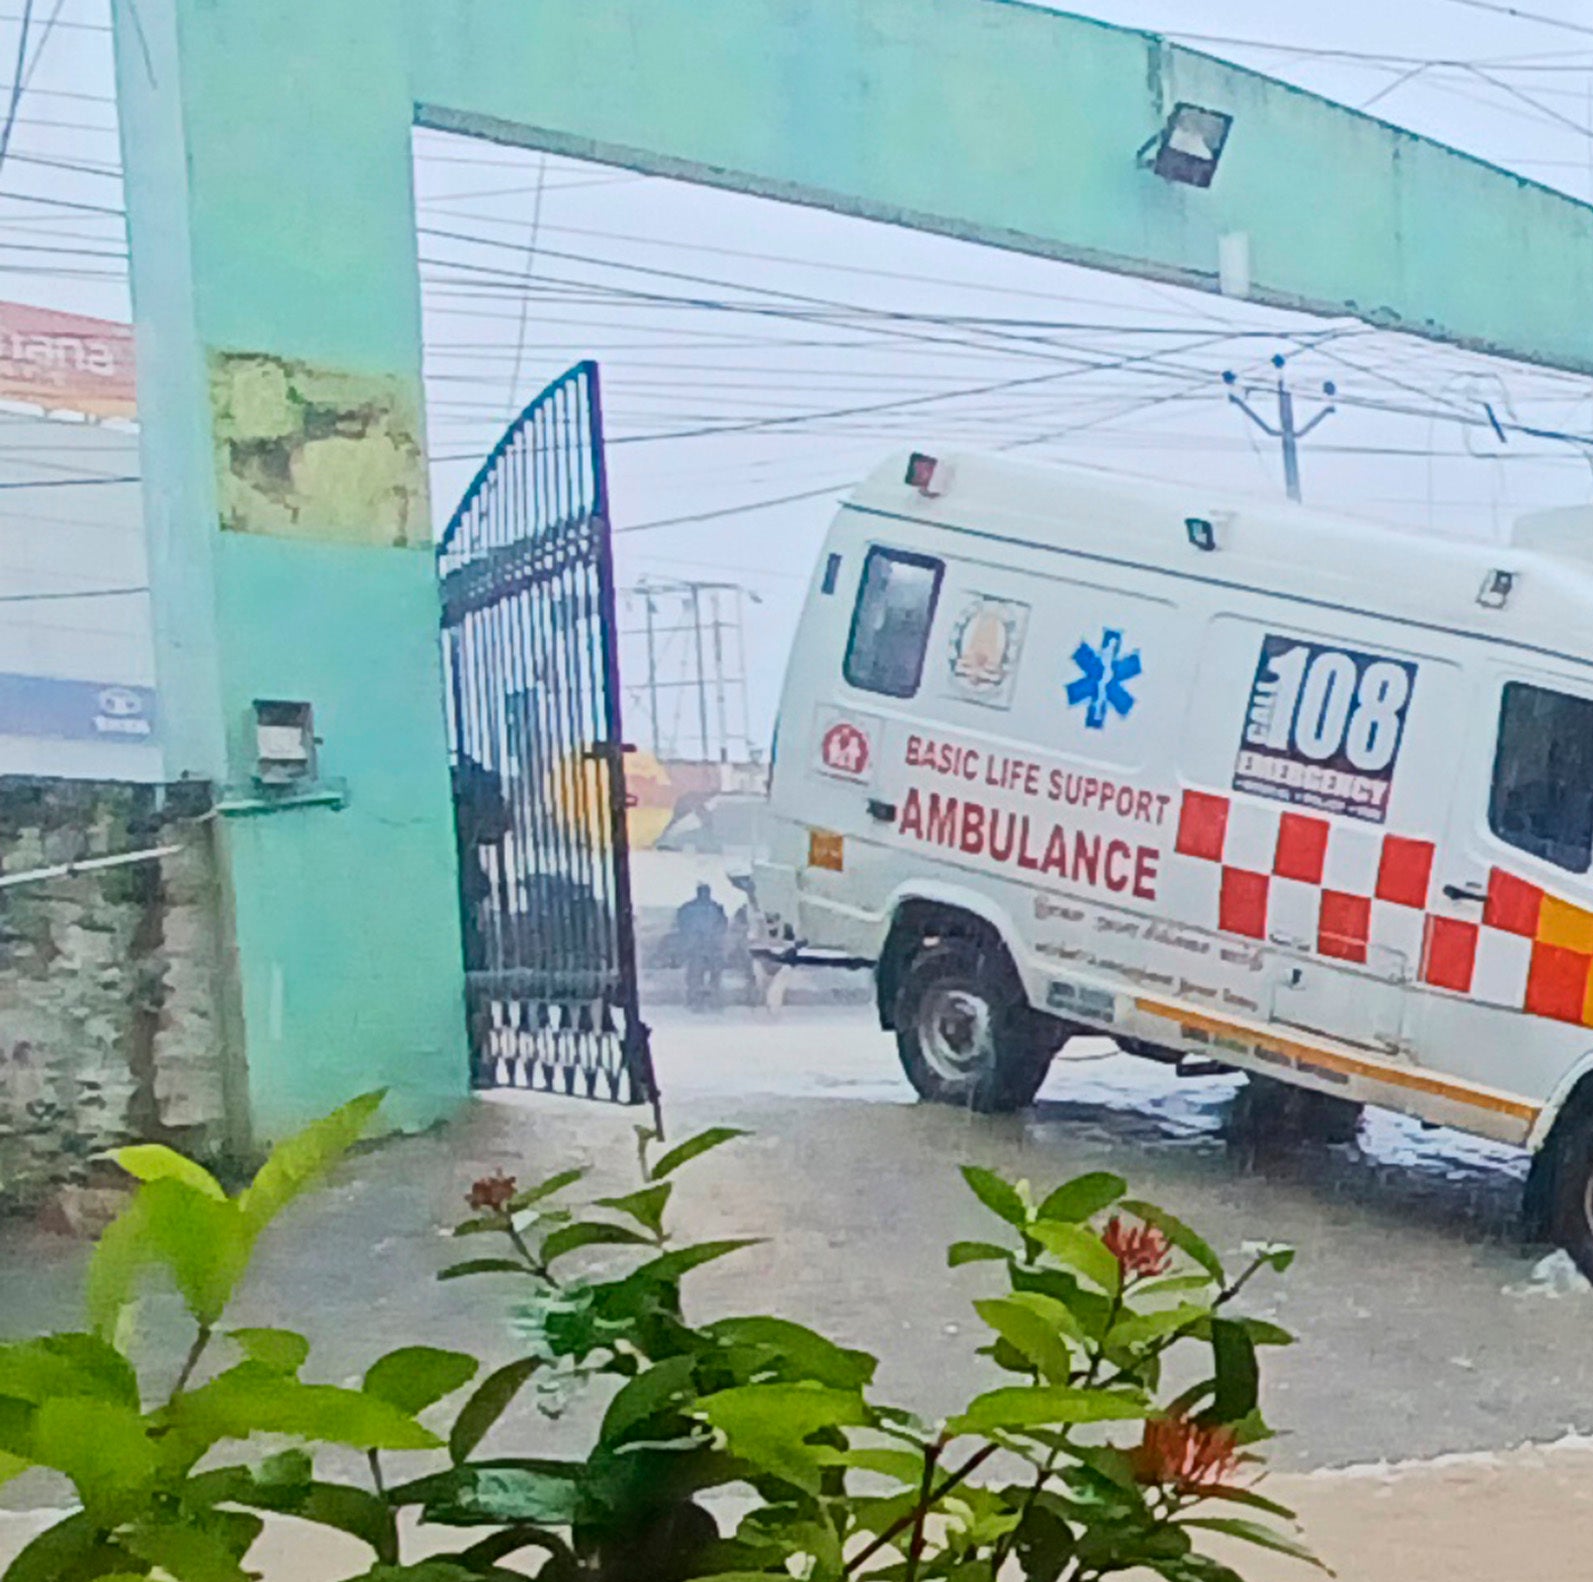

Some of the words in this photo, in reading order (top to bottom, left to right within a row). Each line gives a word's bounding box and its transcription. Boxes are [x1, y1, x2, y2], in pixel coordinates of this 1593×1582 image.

[1247, 681, 1278, 746] CALL
[1267, 646, 1409, 771] 108
[904, 734, 980, 781] BASIC
[984, 754, 1040, 796] LIFE
[1047, 768, 1171, 825] SUPPORT
[1236, 750, 1390, 806] EMERGENCY
[898, 786, 1161, 901] AMBULANCE
